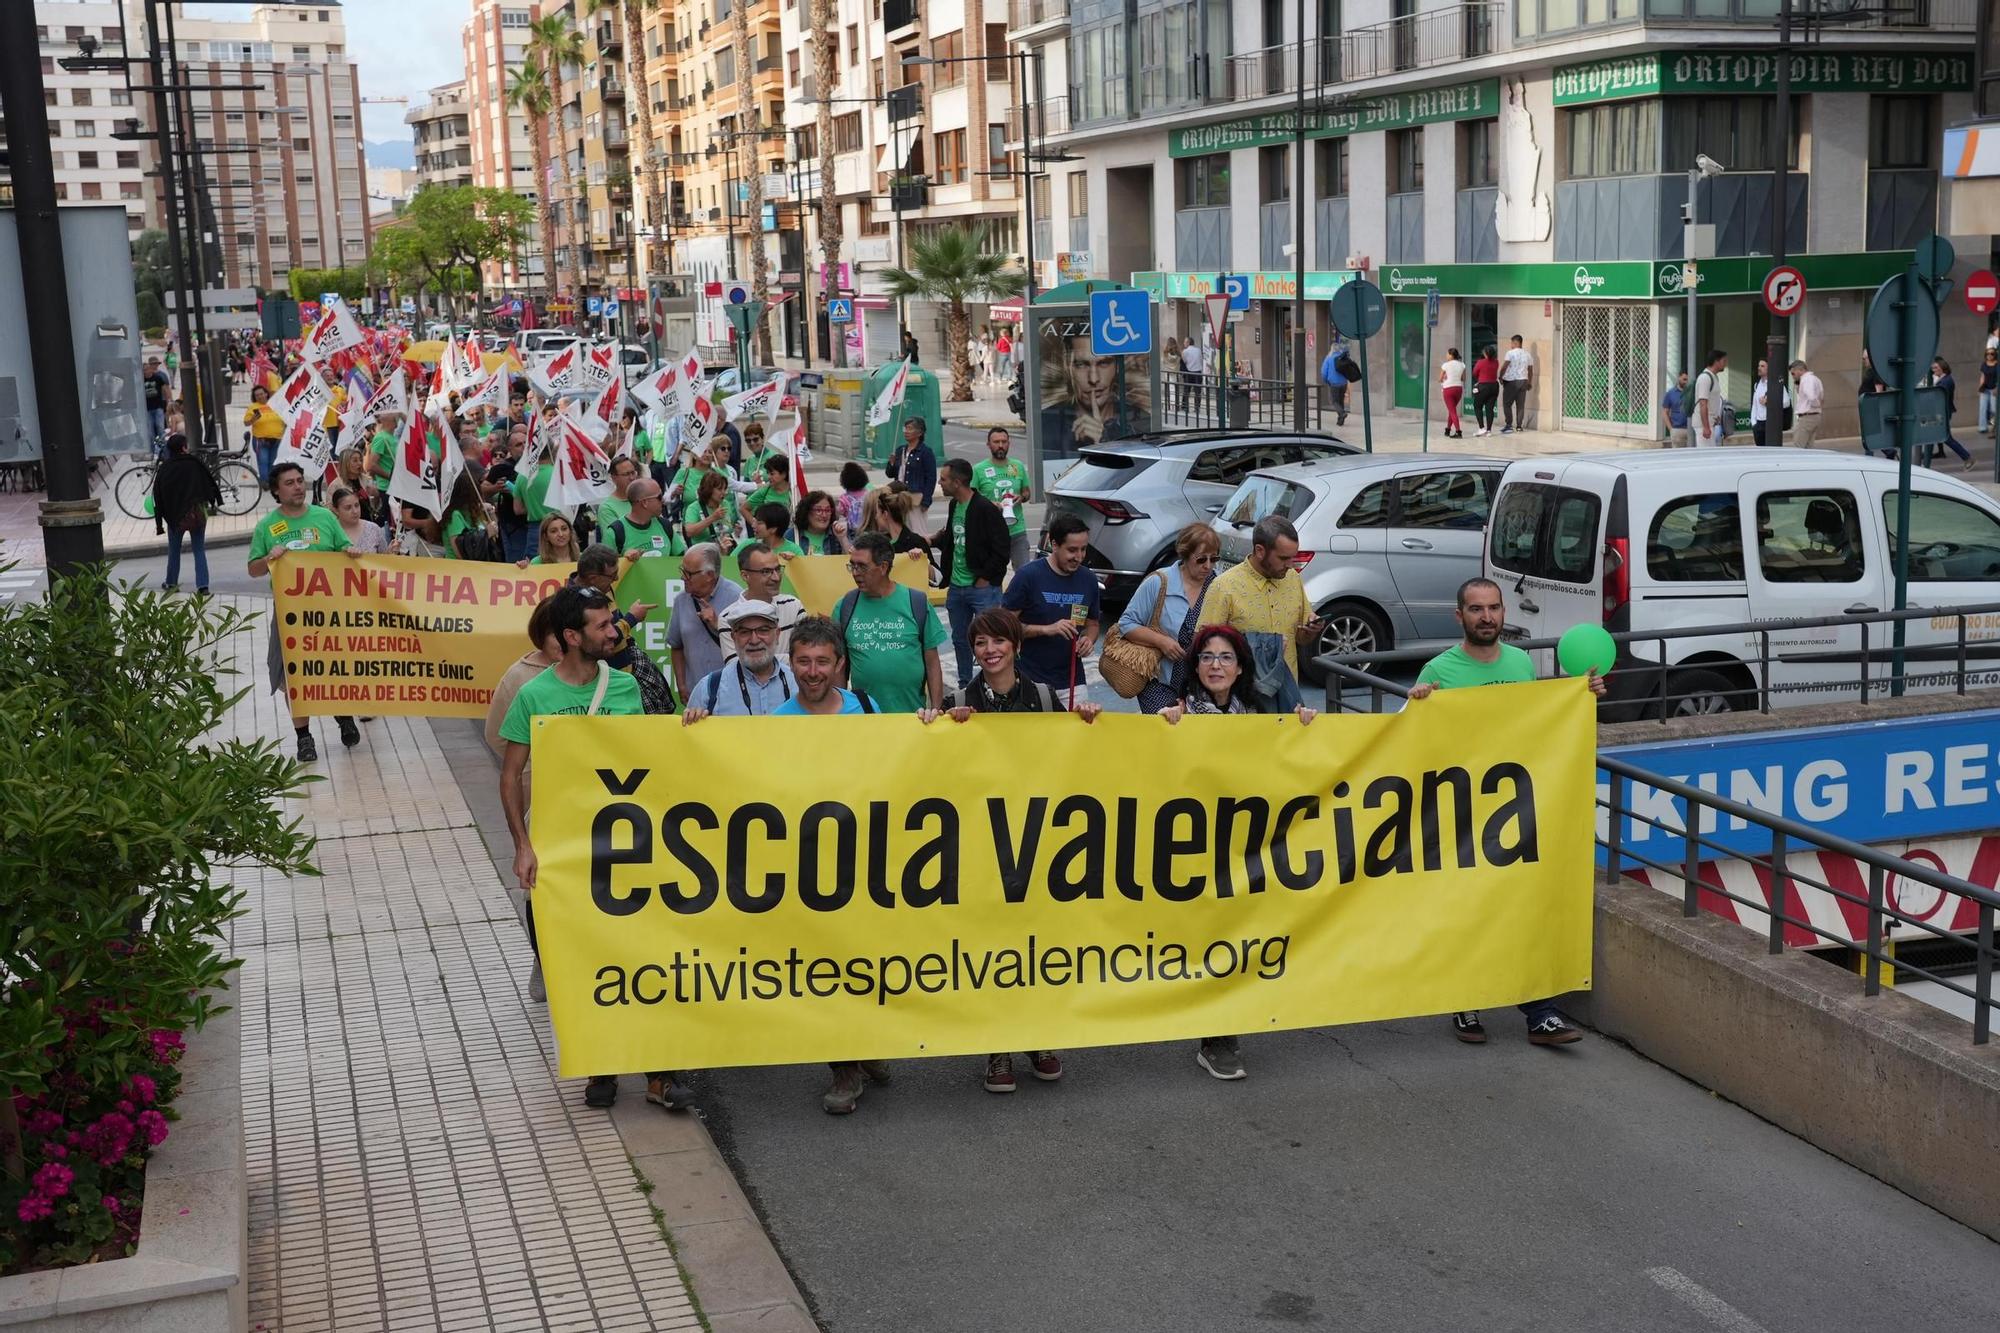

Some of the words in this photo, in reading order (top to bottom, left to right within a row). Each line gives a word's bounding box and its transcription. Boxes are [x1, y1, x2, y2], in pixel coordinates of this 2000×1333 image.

[1555, 56, 1659, 97] ORTOPEDIA
[1912, 57, 1967, 85] DON
[1407, 86, 1468, 123] JAIME
[1061, 253, 1089, 263] ATLAS
[1189, 273, 1210, 294] Don
[1254, 275, 1297, 295] Marke
[1225, 280, 1243, 298] P
[284, 567, 334, 596] JA
[344, 567, 415, 600] N'HI
[426, 574, 479, 606] HA
[489, 578, 569, 607] PRO
[303, 610, 325, 628] NO
[329, 611, 341, 628] A
[345, 611, 374, 628] LES
[378, 611, 474, 634] RETALLADES
[1931, 615, 1981, 630] GUIJARO
[303, 630, 320, 652] SÍ
[323, 635, 343, 652] AL
[347, 633, 423, 655] VALENCIÀ
[303, 660, 325, 677] NO
[329, 660, 350, 677] AL
[354, 660, 435, 679] DISTRICTE
[438, 659, 475, 681] ÚNIC
[303, 685, 371, 702] MILLORA
[375, 685, 395, 702] DE
[400, 685, 427, 702] LES
[430, 686, 496, 705] CONDICI
[1884, 743, 2000, 814] RE
[986, 761, 1539, 902] valenciana
[593, 931, 1290, 1008] activistespelvalencia.org
